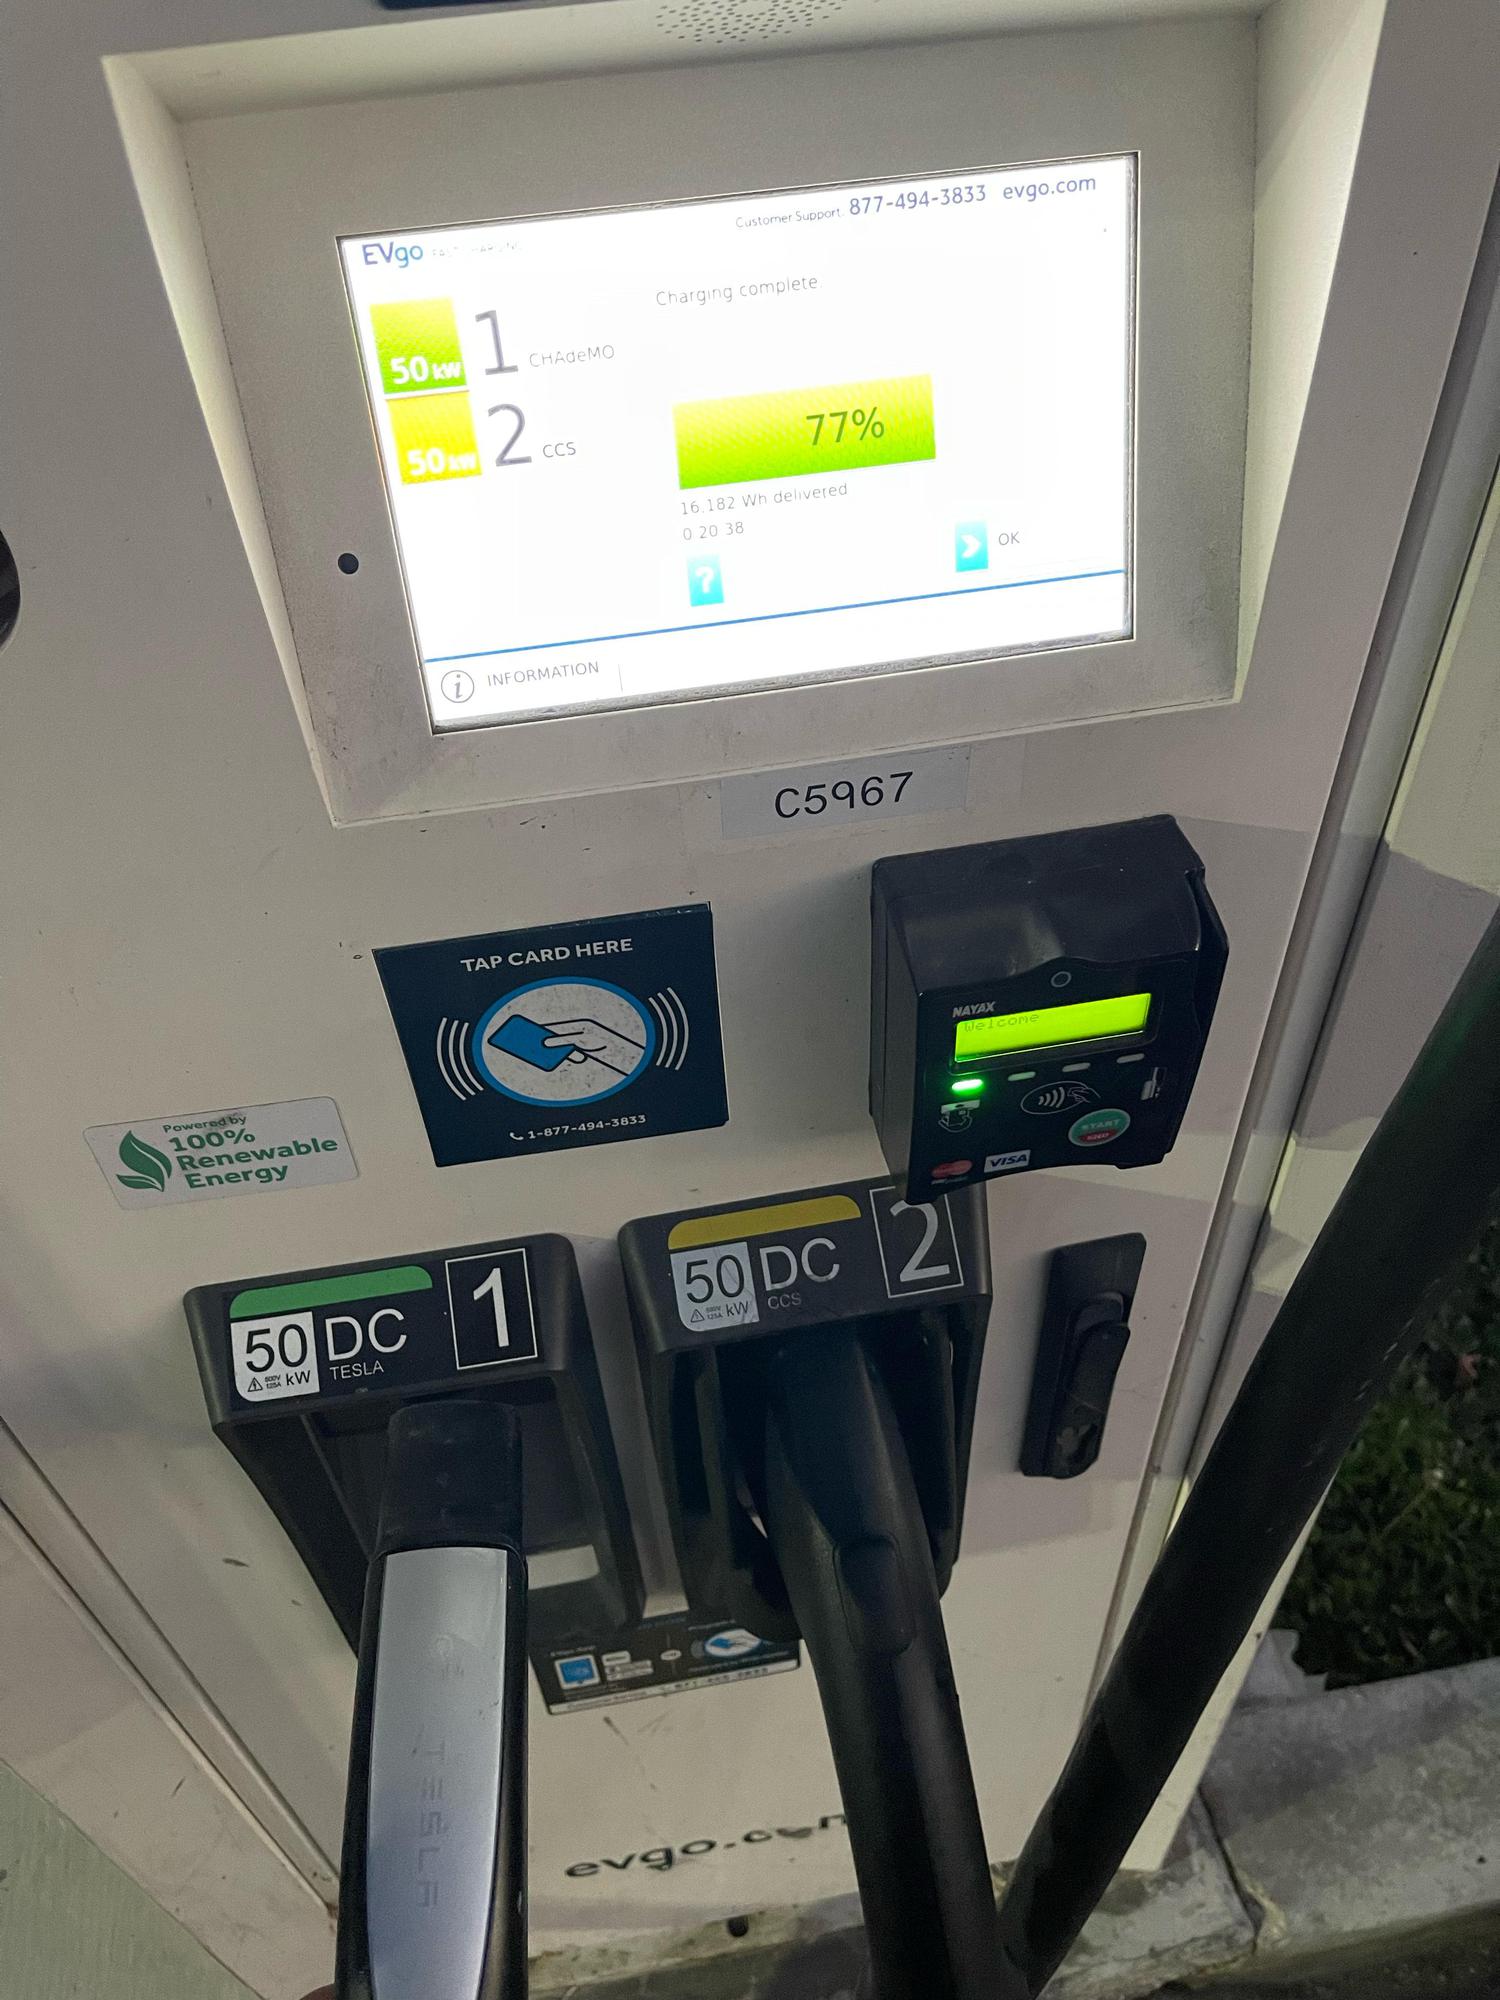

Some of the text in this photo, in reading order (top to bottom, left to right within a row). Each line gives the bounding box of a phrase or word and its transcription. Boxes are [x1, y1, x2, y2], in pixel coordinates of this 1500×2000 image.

[736, 213, 792, 228] Customer
[849, 184, 987, 216] 877-494-3833
[1002, 176, 1097, 203] evgo.com
[362, 241, 424, 268] EVgo
[656, 286, 733, 306] Charging
[474, 309, 519, 376] 1
[529, 344, 615, 368] CHAdeMO
[390, 355, 429, 385] 50
[487, 403, 533, 467] 2
[805, 406, 885, 446] 77%
[407, 447, 446, 477] 50
[542, 441, 577, 459] CCS
[742, 492, 768, 508] Wh
[773, 482, 848, 505] delivered
[998, 531, 1020, 546] OK
[487, 660, 600, 687] INFORMATION
[773, 770, 914, 820] C5967
[460, 937, 634, 973] TAP CARD HERE
[952, 1001, 996, 1019] NAYAX
[963, 1012, 1041, 1033] Welcome
[162, 1114, 248, 1134] Powered by
[527, 1113, 647, 1140] 1-877-494-3833
[168, 1127, 256, 1153] 100%
[175, 1137, 339, 1172] Renewable
[990, 1153, 1028, 1168] VISA
[184, 1164, 290, 1190] Energy
[888, 1199, 951, 1283] 2
[759, 1236, 841, 1292] DC
[685, 1253, 746, 1304] 50
[472, 1266, 510, 1348] 1
[725, 1299, 749, 1317] kW
[767, 1292, 802, 1310] CCS
[245, 1322, 308, 1373] 50
[325, 1307, 408, 1362] DC
[286, 1369, 311, 1387] kW
[329, 1359, 385, 1381] TESLA
